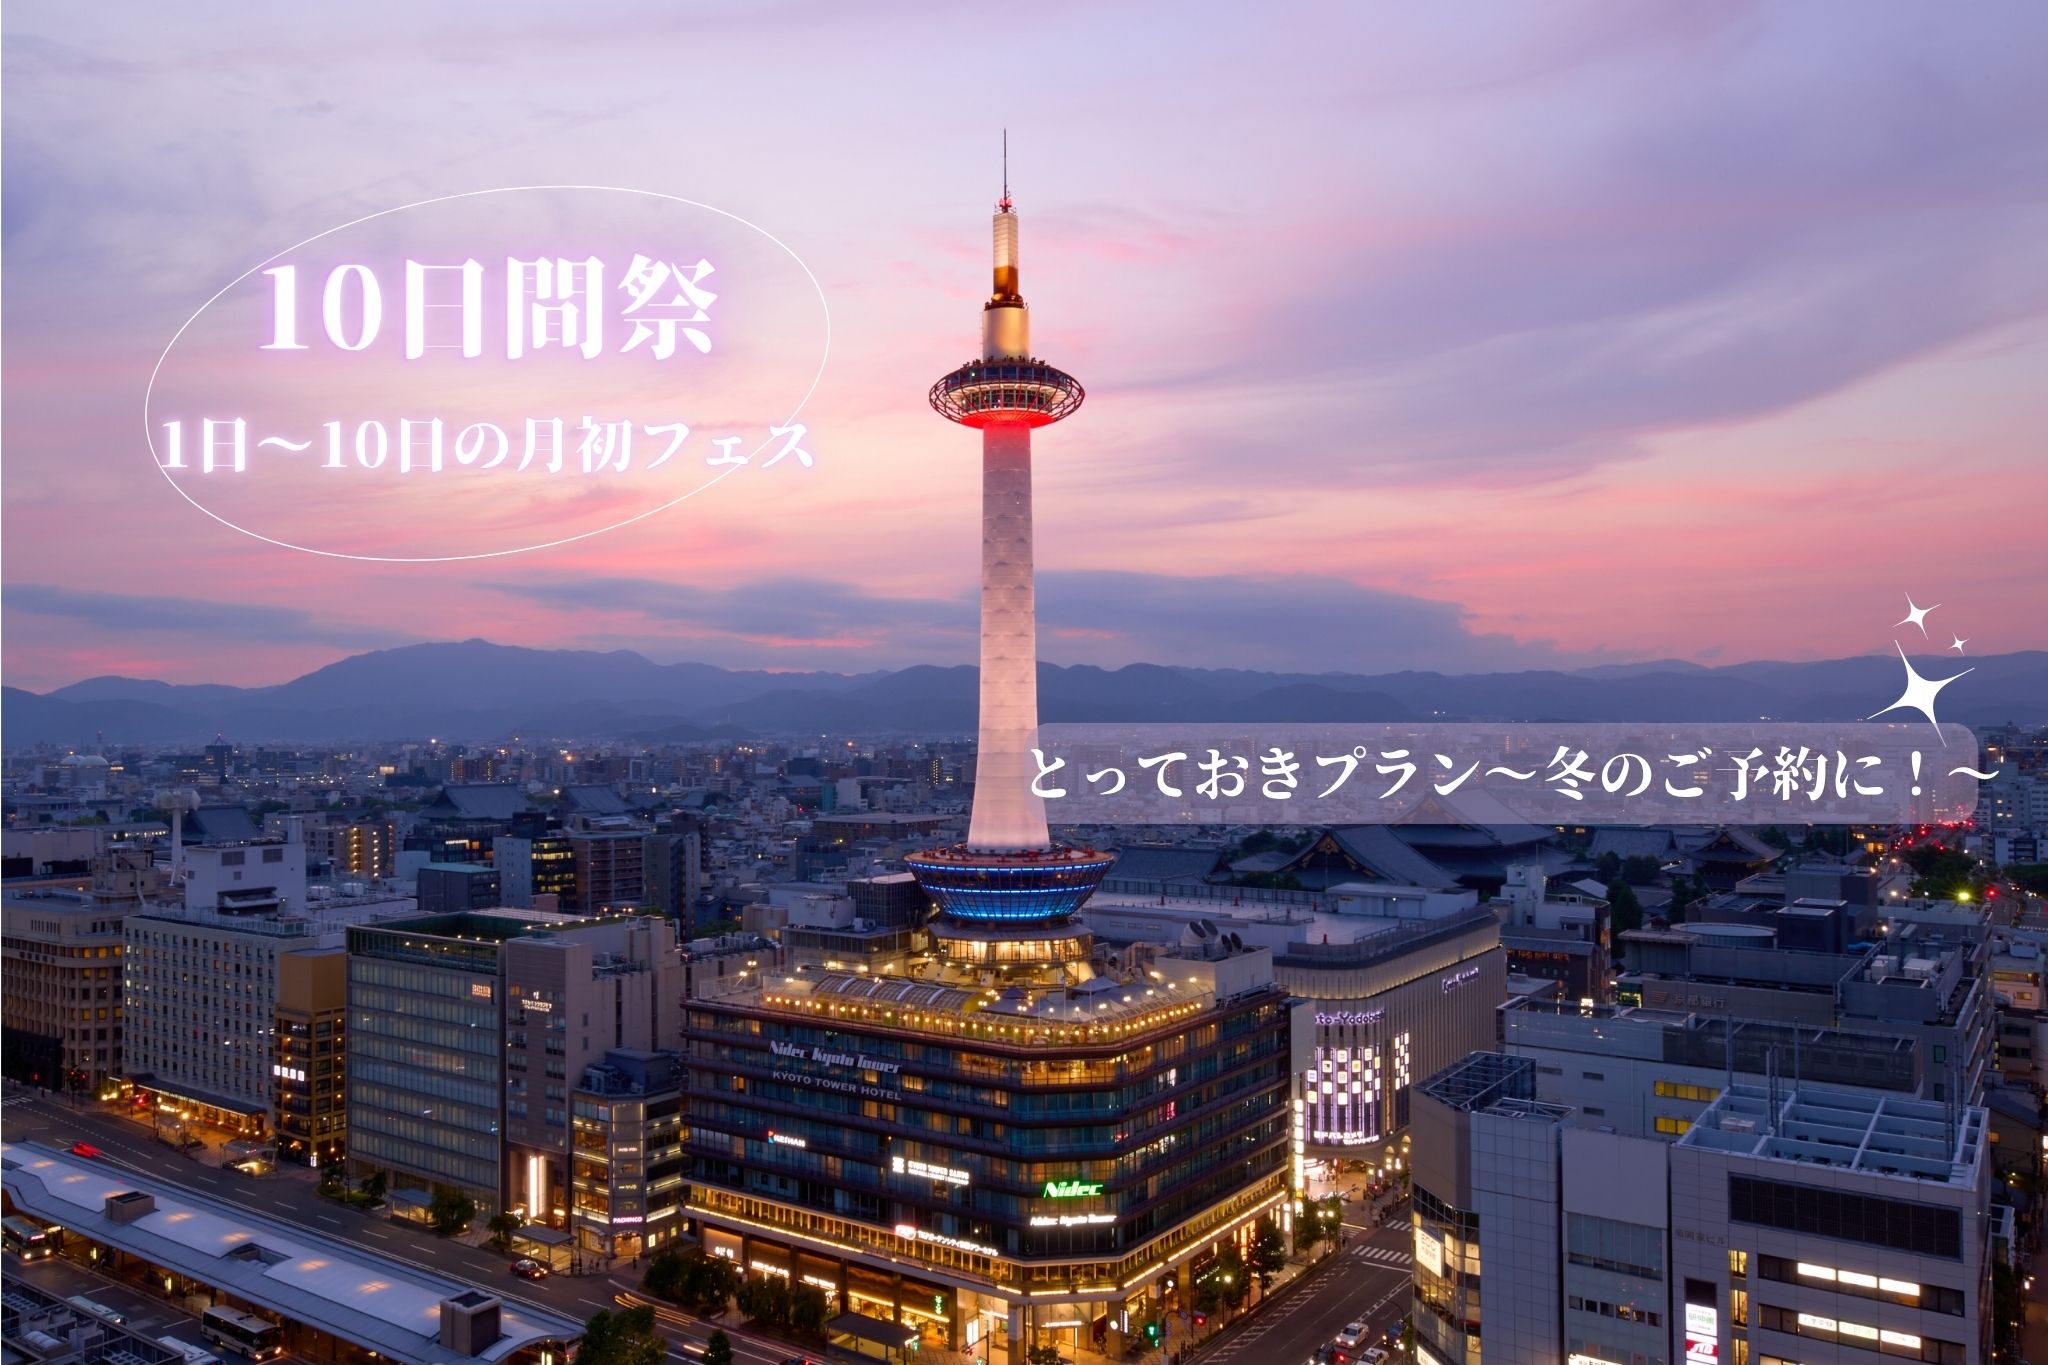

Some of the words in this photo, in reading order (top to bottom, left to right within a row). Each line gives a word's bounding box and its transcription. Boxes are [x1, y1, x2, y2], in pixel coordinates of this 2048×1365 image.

[769, 1040, 808, 1059] Nidec
[812, 1047, 854, 1067] Kyoto
[857, 1054, 902, 1074] Tower
[773, 1071, 811, 1085] KYOTO
[815, 1078, 857, 1092] TOWER
[861, 1086, 902, 1100] HOTEL
[773, 1134, 806, 1148] KEIHAN
[1043, 1181, 1104, 1198] Nidec
